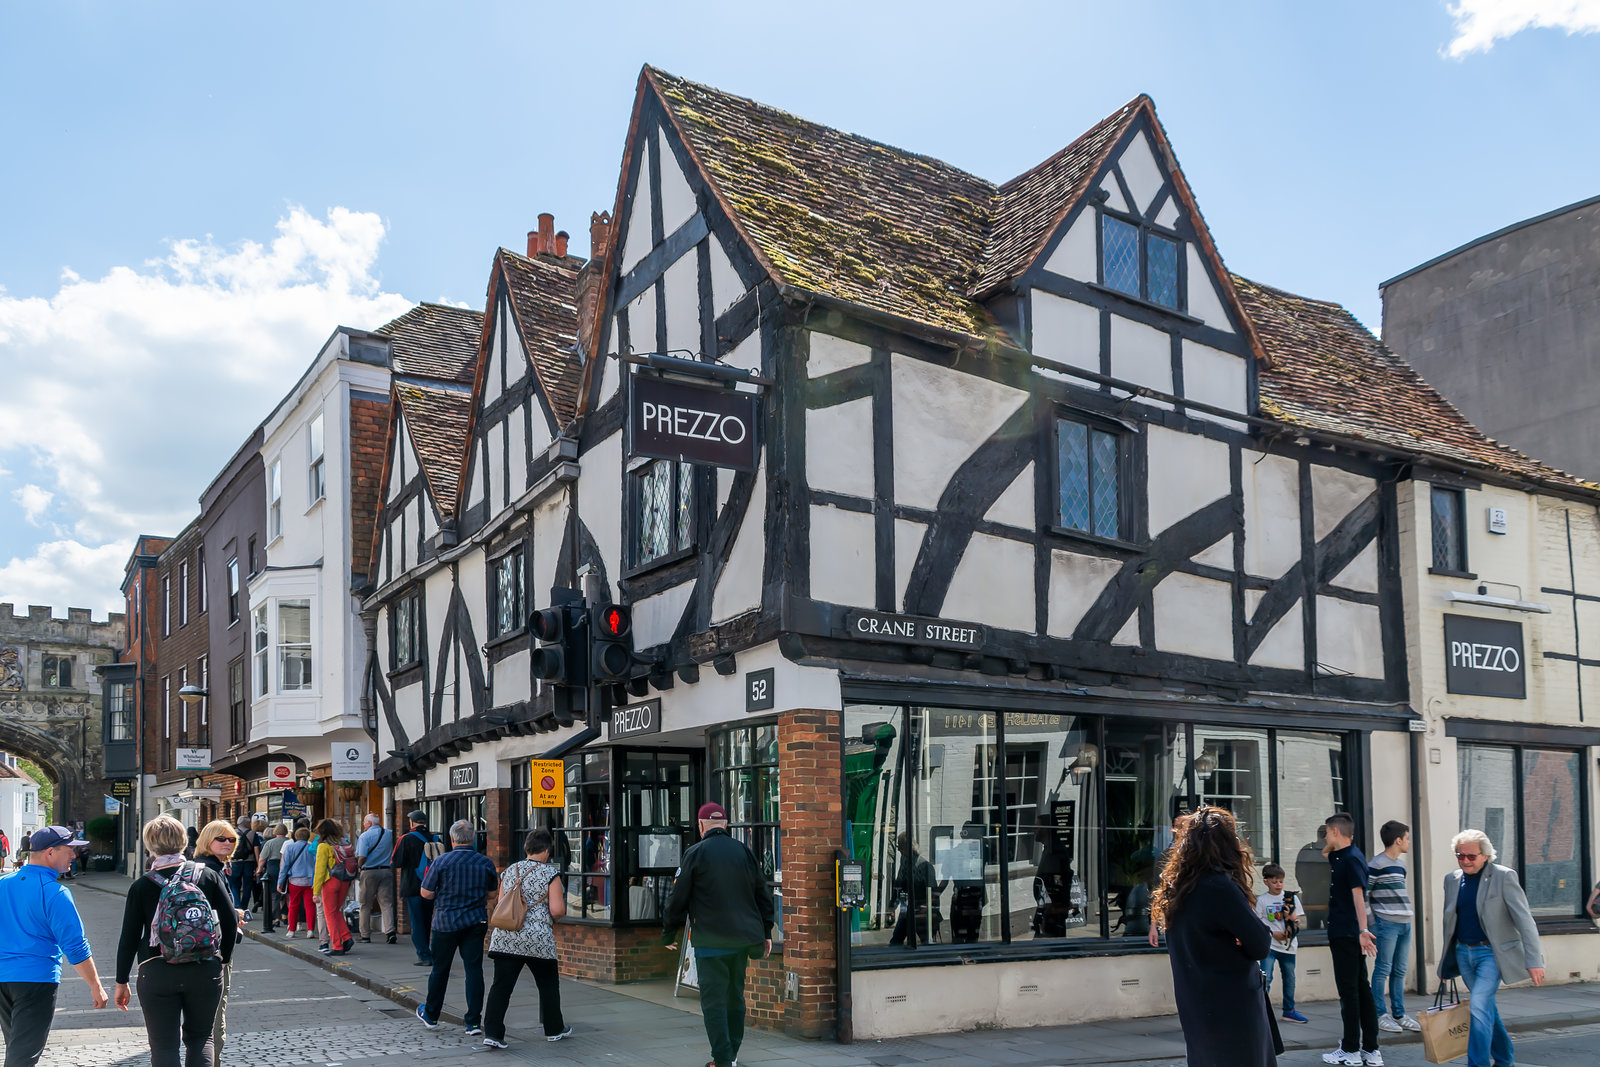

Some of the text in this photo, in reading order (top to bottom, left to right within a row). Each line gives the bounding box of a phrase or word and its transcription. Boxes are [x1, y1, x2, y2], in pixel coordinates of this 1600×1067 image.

[642, 402, 746, 444] PREZZO
[857, 617, 976, 643] CRANE STREET
[1452, 641, 1520, 672] PREZZO
[752, 679, 766, 701] 52
[614, 705, 652, 734] PREZZO
[452, 767, 474, 786] PREZZO
[188, 909, 198, 918] 23
[1448, 1022, 1469, 1036] M&S
